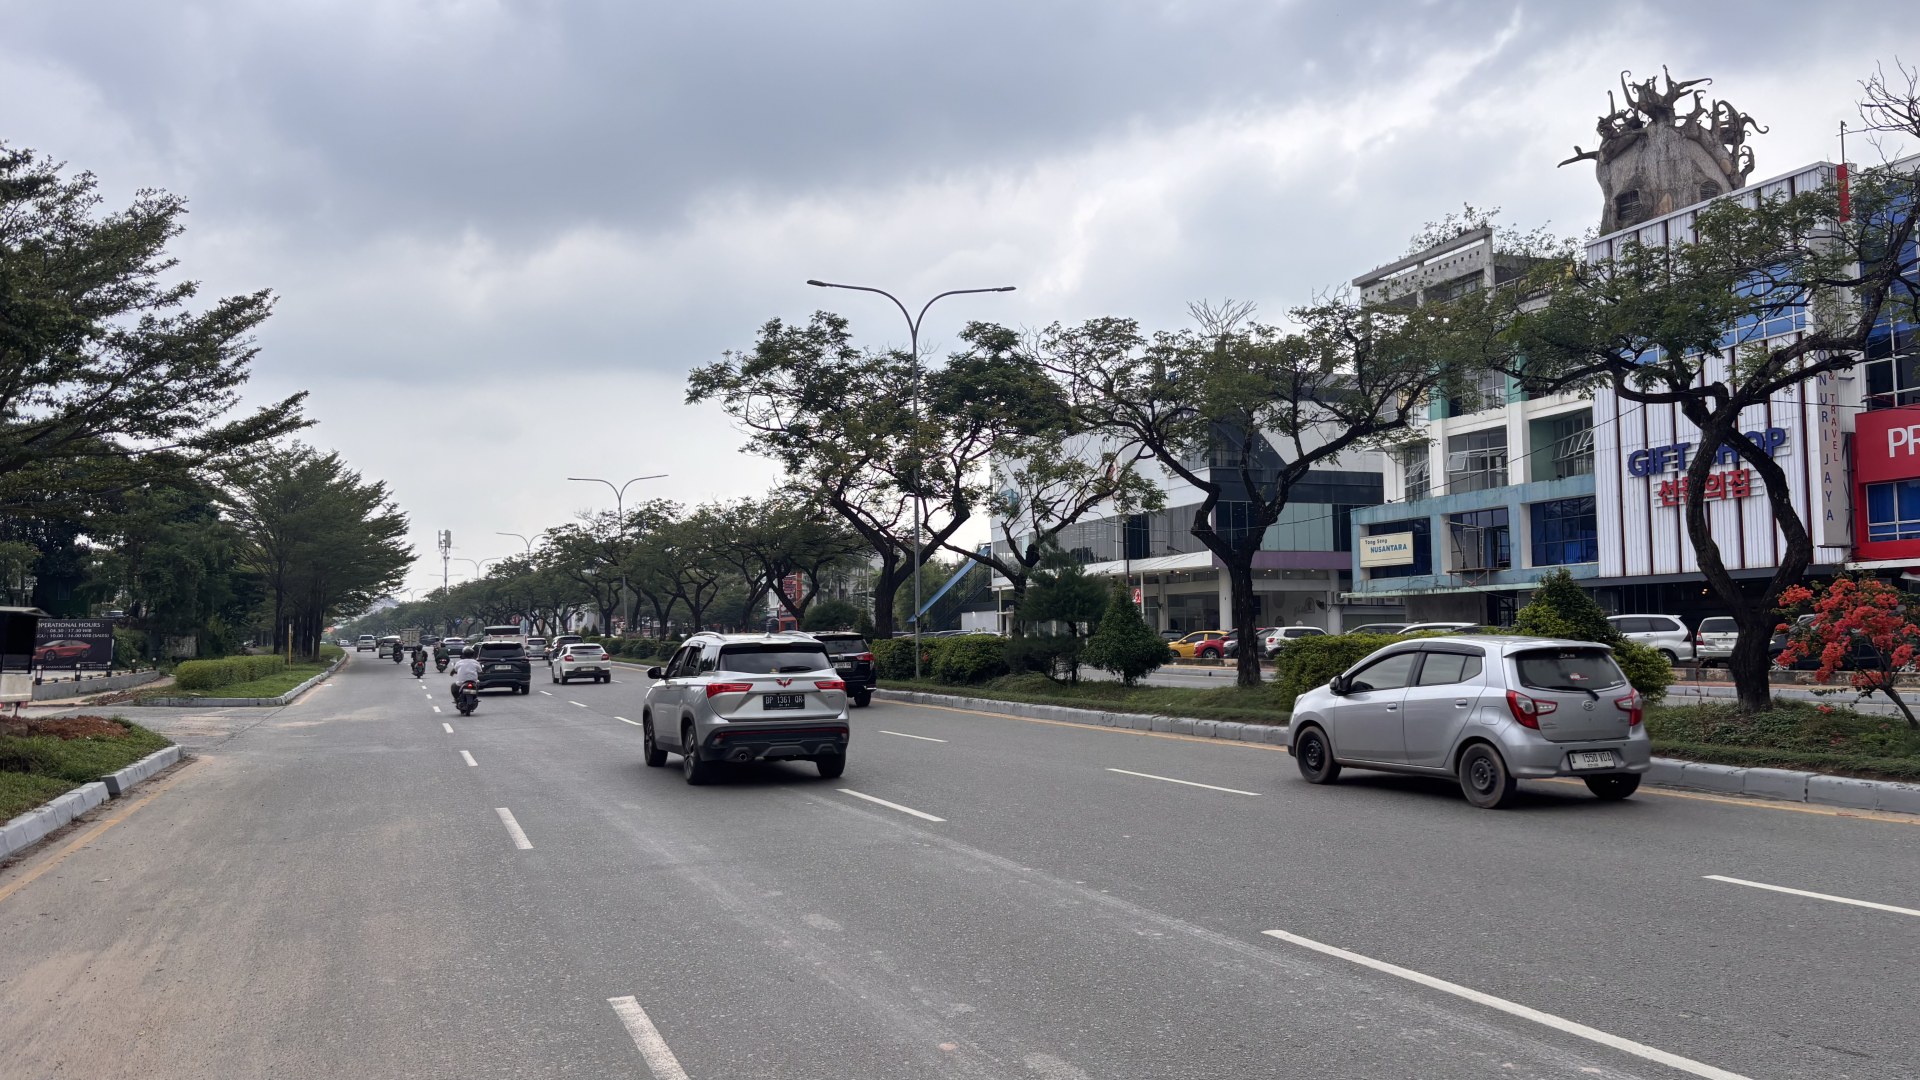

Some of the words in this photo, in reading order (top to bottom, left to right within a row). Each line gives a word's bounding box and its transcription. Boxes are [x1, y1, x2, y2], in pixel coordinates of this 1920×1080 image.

[1628, 442, 1691, 477] GIFT
[1711, 427, 1786, 466] HOP
[1830, 394, 1838, 461] TRAVEL
[1824, 454, 1834, 521] JAYA
[1370, 544, 1407, 553] NUSANTARA
[765, 696, 774, 704] BP
[777, 696, 791, 704] 1361
